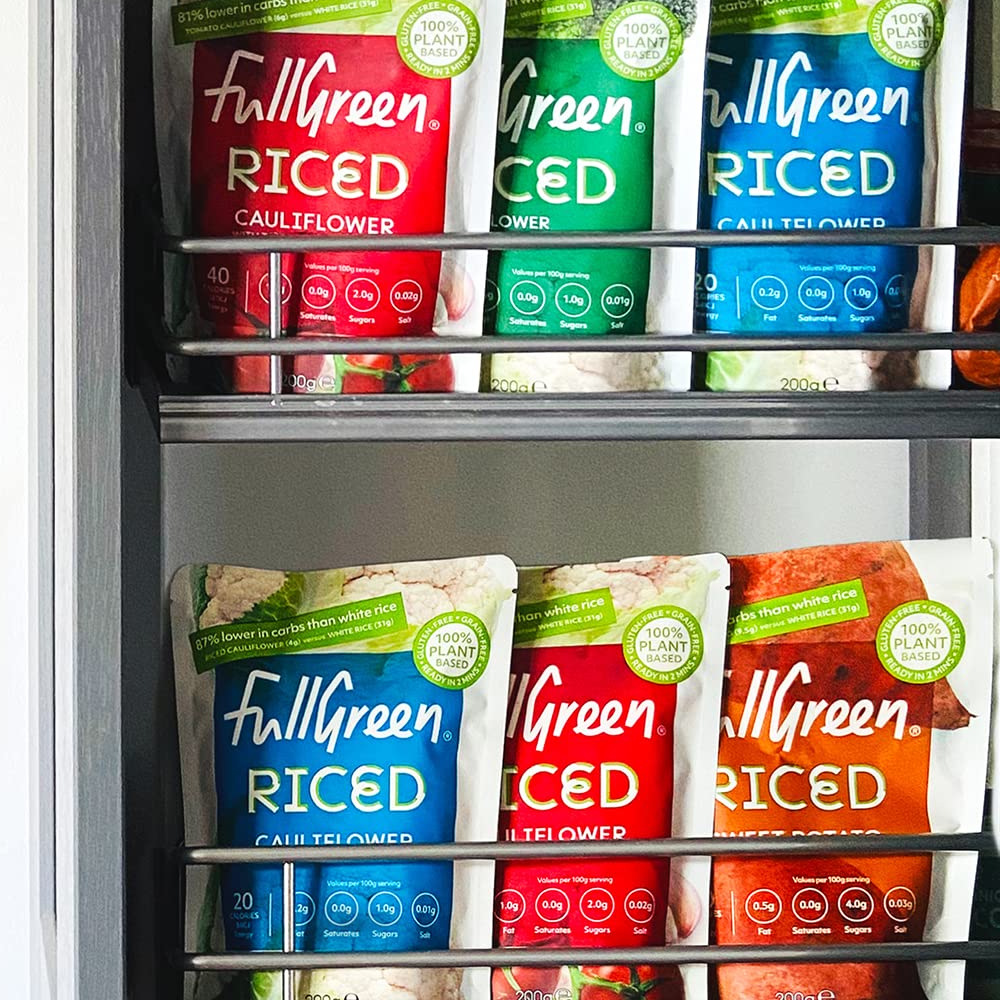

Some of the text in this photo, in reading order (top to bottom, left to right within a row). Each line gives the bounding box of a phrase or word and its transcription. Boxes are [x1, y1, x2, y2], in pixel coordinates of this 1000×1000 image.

[178, 8, 204, 24] 81%
[205, 4, 239, 18] lower
[240, 3, 252, 14] in
[313, 4, 340, 16] WHITE
[420, 20, 460, 33] 100%
[624, 23, 662, 34] 100%
[400, 2, 471, 74] GLUTEN-FREE READY MINS
[414, 34, 465, 46] PLANT
[616, 36, 667, 49] PLANT
[896, 40, 929, 49] BASED
[420, 48, 458, 58] BASED
[624, 50, 660, 60] BASED
[880, 46, 910, 67] READY
[610, 55, 674, 78] READY MINS
[498, 57, 632, 143] Green
[227, 146, 410, 200] RICED
[707, 150, 896, 197] RICED
[494, 156, 616, 204] CED
[234, 210, 395, 235] CAULIFLOWER
[491, 215, 550, 230] LOWER
[207, 266, 230, 285] 40
[308, 286, 330, 298] 0.0g
[352, 290, 374, 301] 2.0g
[394, 291, 418, 302] 0.02g
[516, 292, 539, 303] 0.0g
[758, 287, 780, 298] 0.2g
[805, 288, 828, 298] 0.0g
[852, 288, 872, 298] 1.0g
[562, 294, 585, 306] 1.0g
[606, 296, 630, 306] 0.01g
[300, 311, 336, 322] Saturates
[348, 315, 376, 325] Sugars
[509, 316, 547, 328] Saturates
[798, 314, 838, 322] Saturates
[560, 320, 588, 330] Sugars
[543, 596, 605, 618] white rice
[758, 588, 858, 618] than white rice
[195, 602, 398, 650] 87% lower in carbs than white rice
[645, 626, 684, 638] 100%
[900, 622, 942, 636] 100%
[436, 632, 472, 644] 100%
[894, 636, 948, 650] PLANT
[429, 644, 476, 658] PLANT
[638, 640, 688, 652] PLANT
[646, 654, 682, 664] BASED
[901, 652, 941, 662] BASED
[435, 658, 469, 670] BASED
[632, 658, 695, 680] READY MINS
[886, 657, 956, 680] READY MINS
[422, 663, 480, 684] READY MINS
[507, 664, 655, 752] lGreen
[248, 764, 427, 814] RICED
[500, 762, 640, 811] ICED
[233, 892, 254, 911] 20
[542, 900, 563, 910] 0.0g
[586, 900, 608, 910] 2.0g
[628, 901, 652, 912] 0.02g
[752, 900, 775, 912] 0.5g
[799, 900, 822, 911] 0.0g
[845, 899, 868, 910] 4.0g
[888, 898, 912, 910] 0.03g
[331, 903, 352, 914] 0.0g
[375, 903, 396, 914] 1.0g
[416, 904, 436, 917] 0.01g
[323, 929, 360, 938] Saturates
[372, 929, 399, 940] Sugars
[419, 930, 432, 940] Salt
[534, 926, 572, 934] Saturates
[584, 926, 611, 936] Sugars
[757, 926, 772, 936] Fat
[792, 926, 831, 936] Saturates
[844, 925, 872, 935] Sugars
